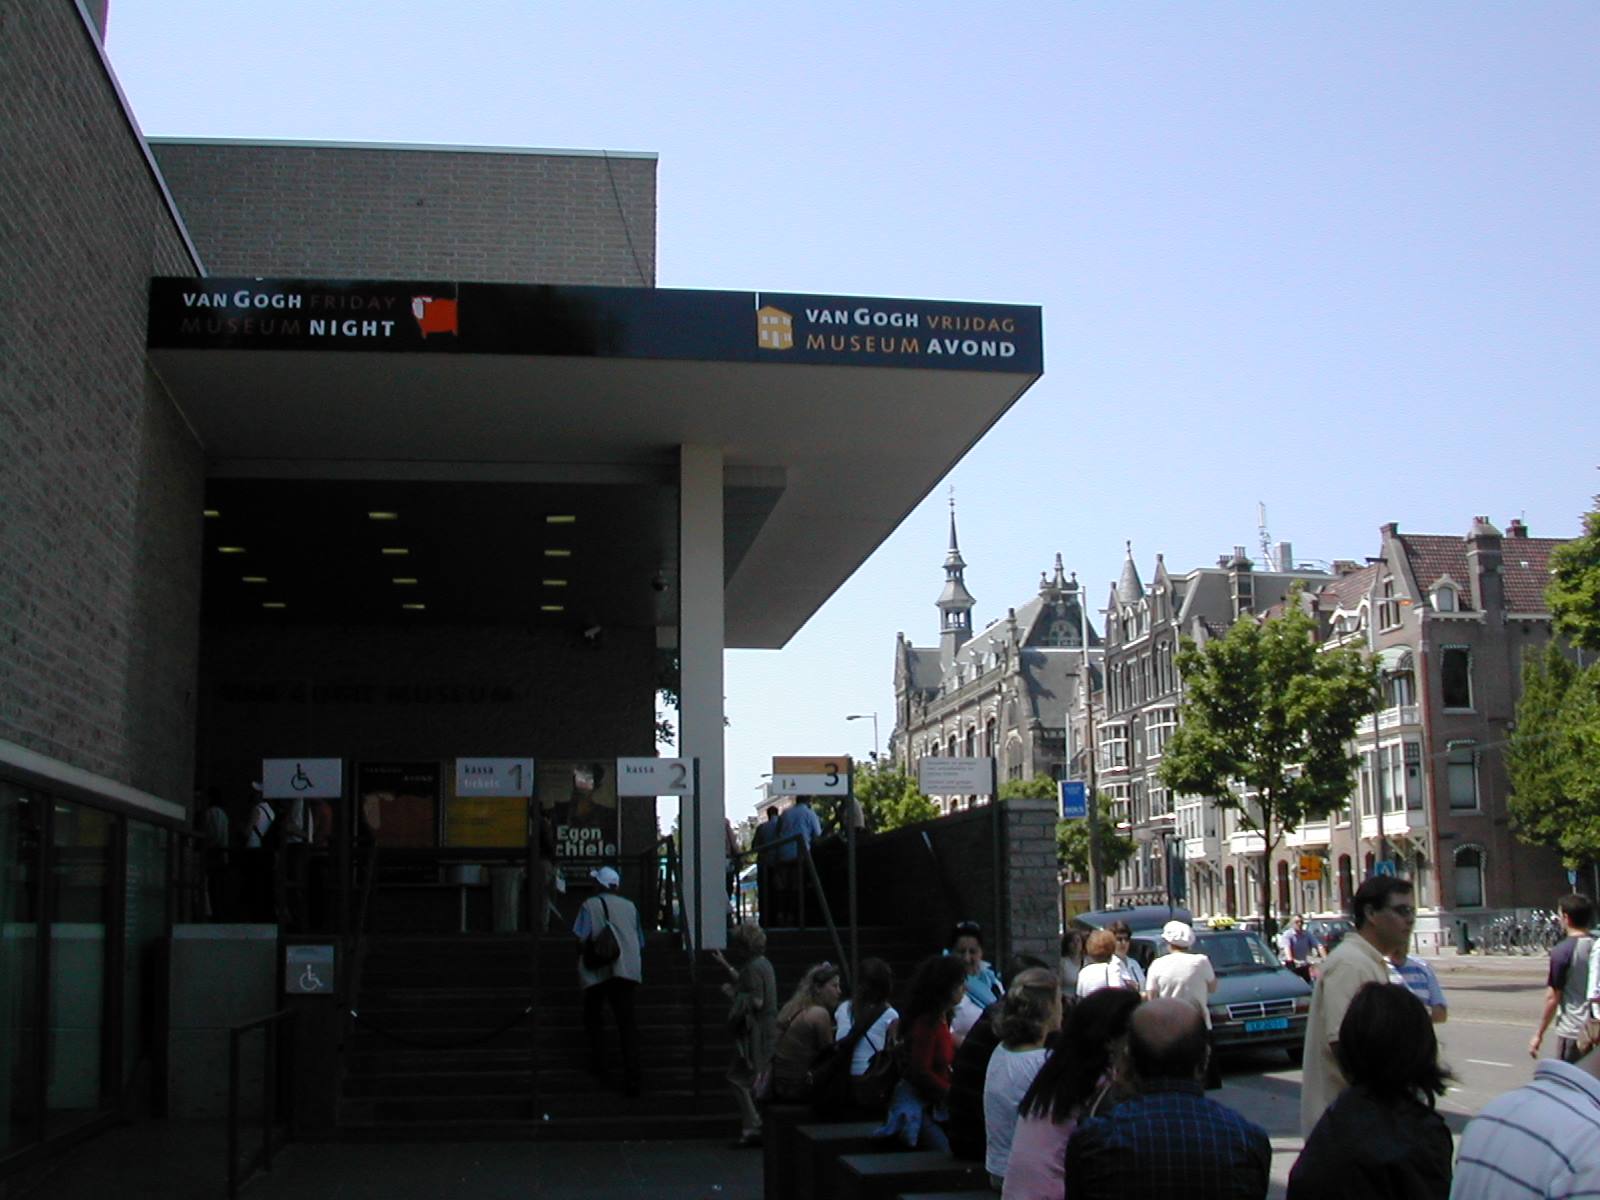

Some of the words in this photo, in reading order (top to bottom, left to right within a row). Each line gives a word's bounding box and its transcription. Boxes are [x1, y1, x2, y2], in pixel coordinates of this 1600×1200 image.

[182, 293, 228, 308] VAN
[233, 289, 302, 309] GOGH
[310, 294, 396, 310] FRIDAY
[181, 318, 301, 335] MUSEUM
[309, 319, 396, 337] NIGHT
[805, 308, 849, 325] VAN
[854, 307, 919, 328] GOGH
[927, 315, 1015, 333] VRIJDAG
[806, 334, 920, 353] MUSEUM
[927, 338, 1016, 358] AVOND
[508, 764, 522, 791] 1
[626, 765, 655, 774] kassa
[668, 763, 687, 789] 2
[823, 762, 839, 787] 3
[556, 825, 602, 842] Egon
